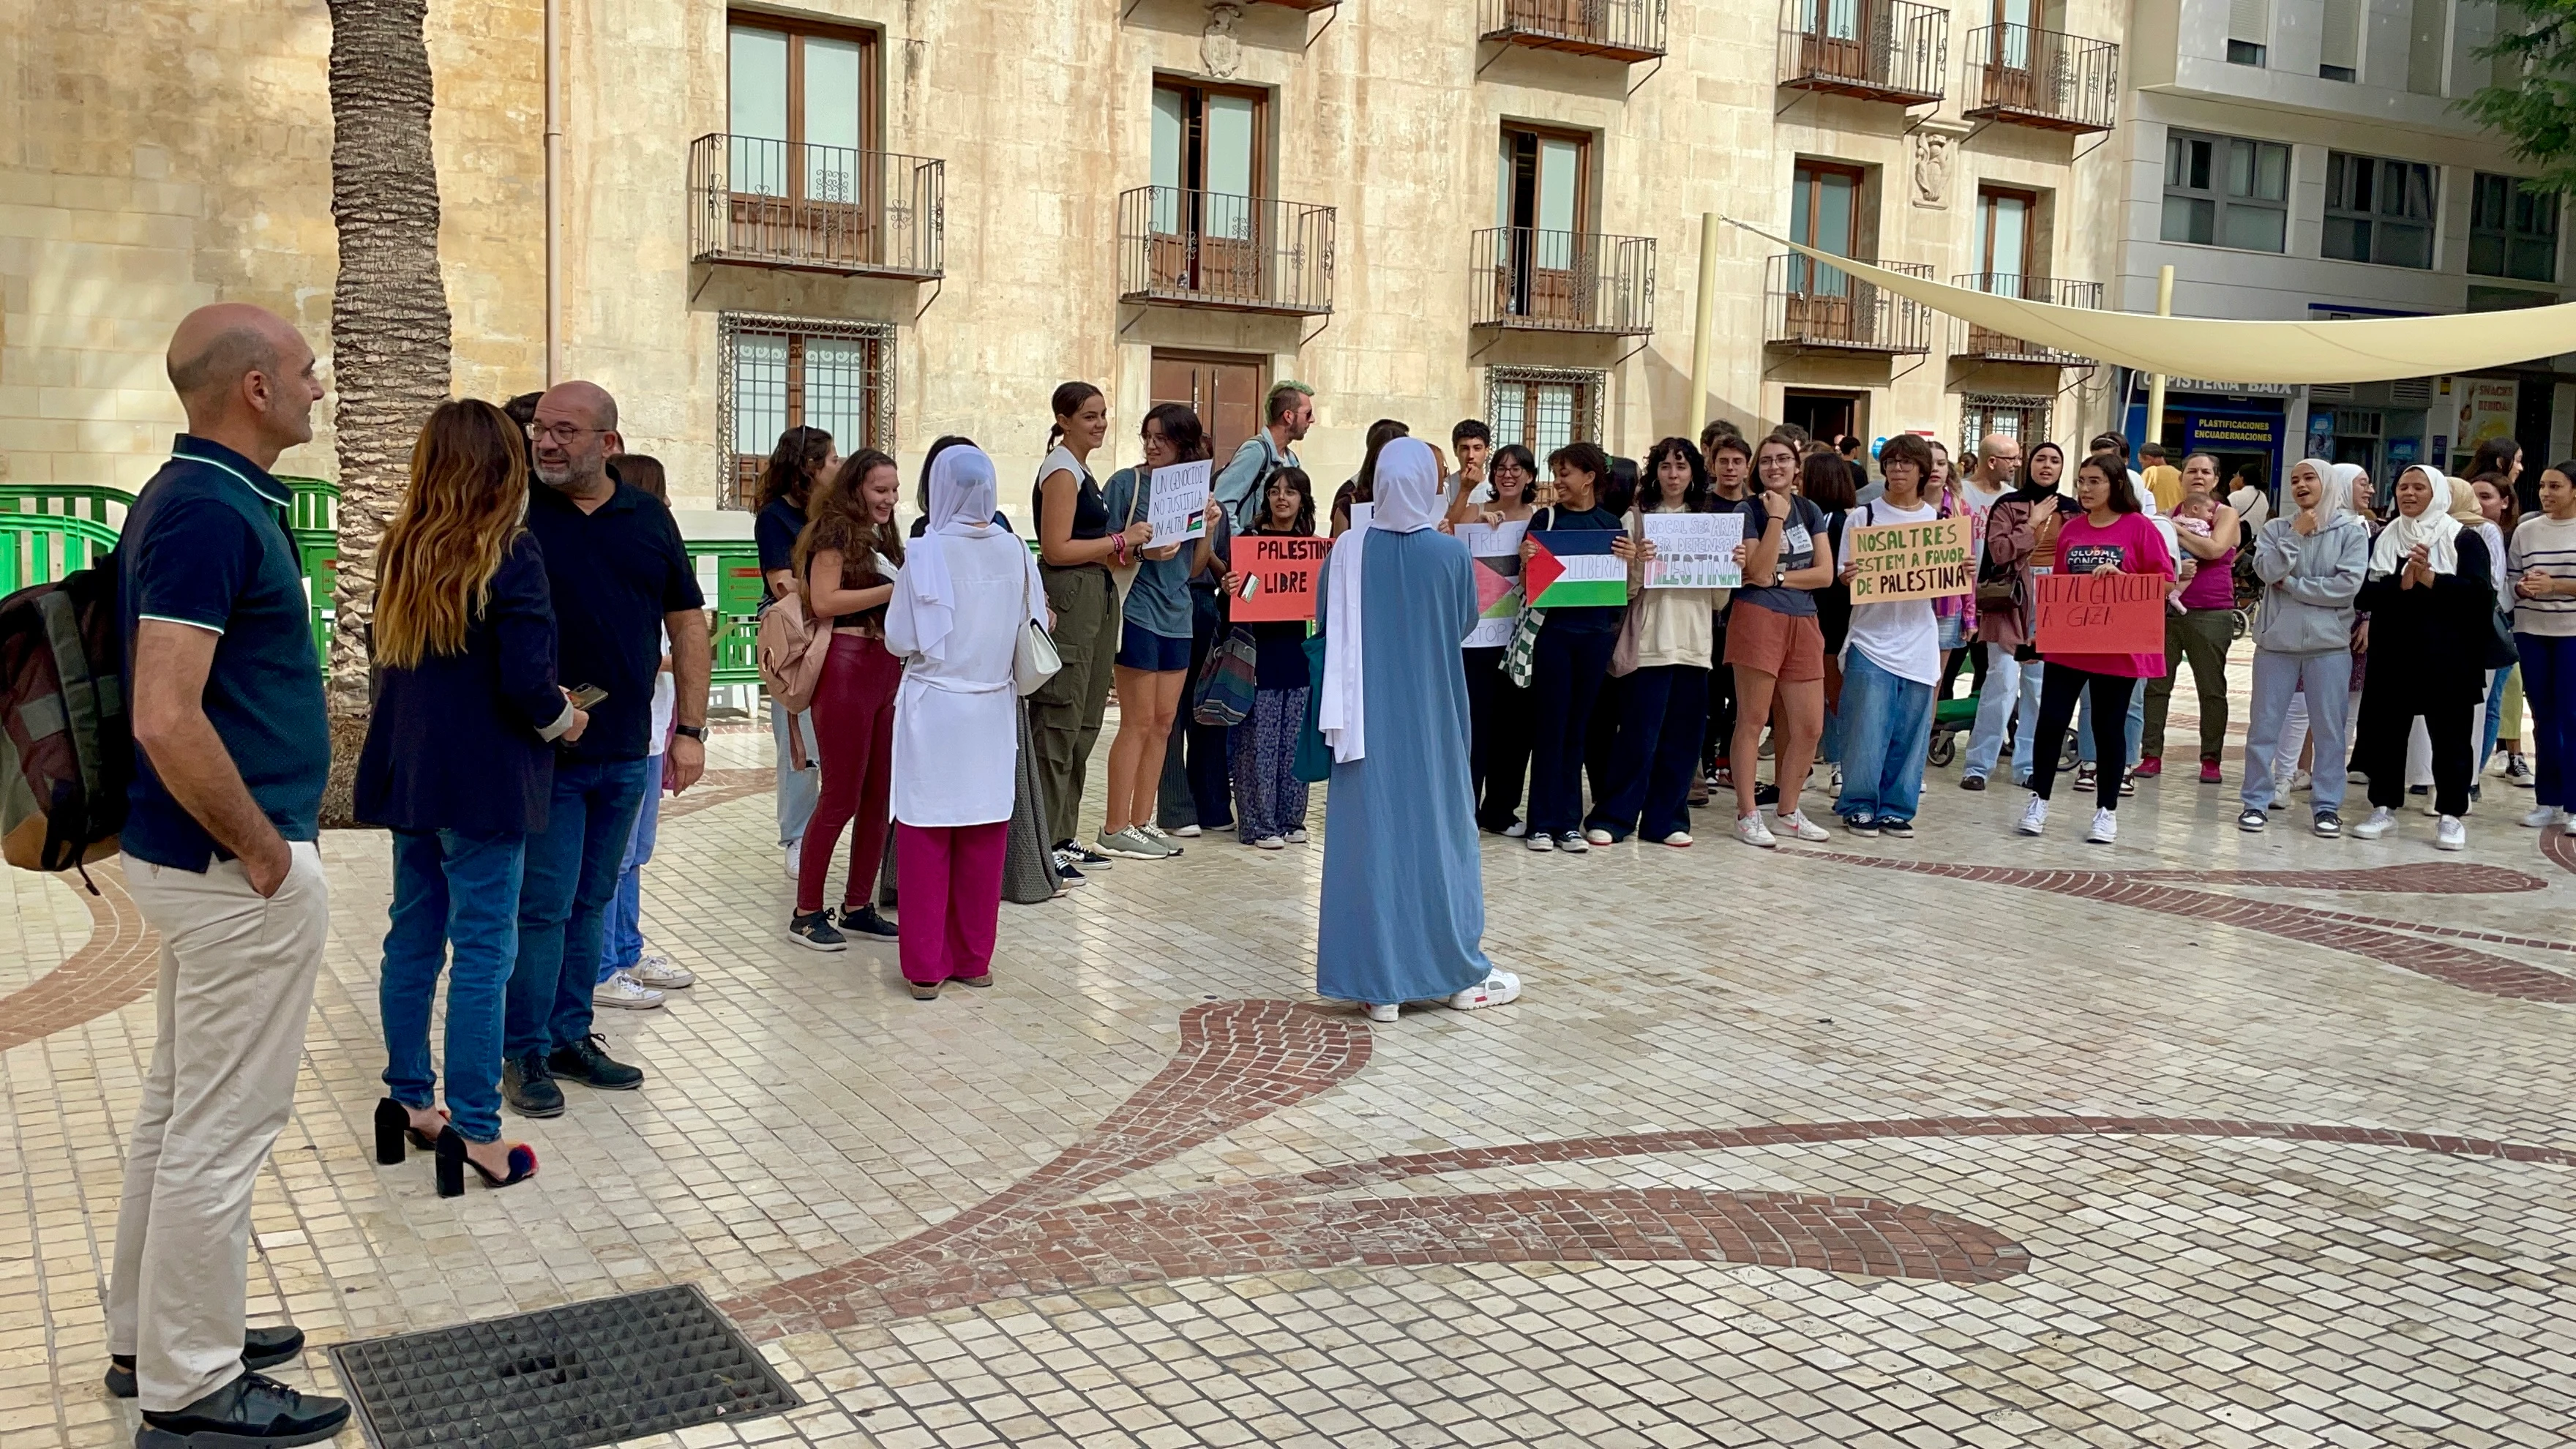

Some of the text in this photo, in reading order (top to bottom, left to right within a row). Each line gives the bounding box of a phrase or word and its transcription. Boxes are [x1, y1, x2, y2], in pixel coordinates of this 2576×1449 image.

[2198, 419, 2269, 430] PLASTIFICACIONES
[2194, 430, 2272, 442] ENCUADERNACIONES
[1156, 475, 1167, 495] UN
[1153, 490, 1202, 516] NO JUSTIFICA
[1165, 514, 1186, 535] ALTRE
[1689, 517, 1710, 534] SER
[1468, 532, 1508, 552] FREE
[1857, 524, 1957, 553] NOSALTRES
[1855, 547, 1965, 574] ESTEM A FAVOR
[1265, 571, 1307, 594] LIBRE
[1857, 564, 1966, 596] DE PALESTINA
[2042, 606, 2052, 627] A
